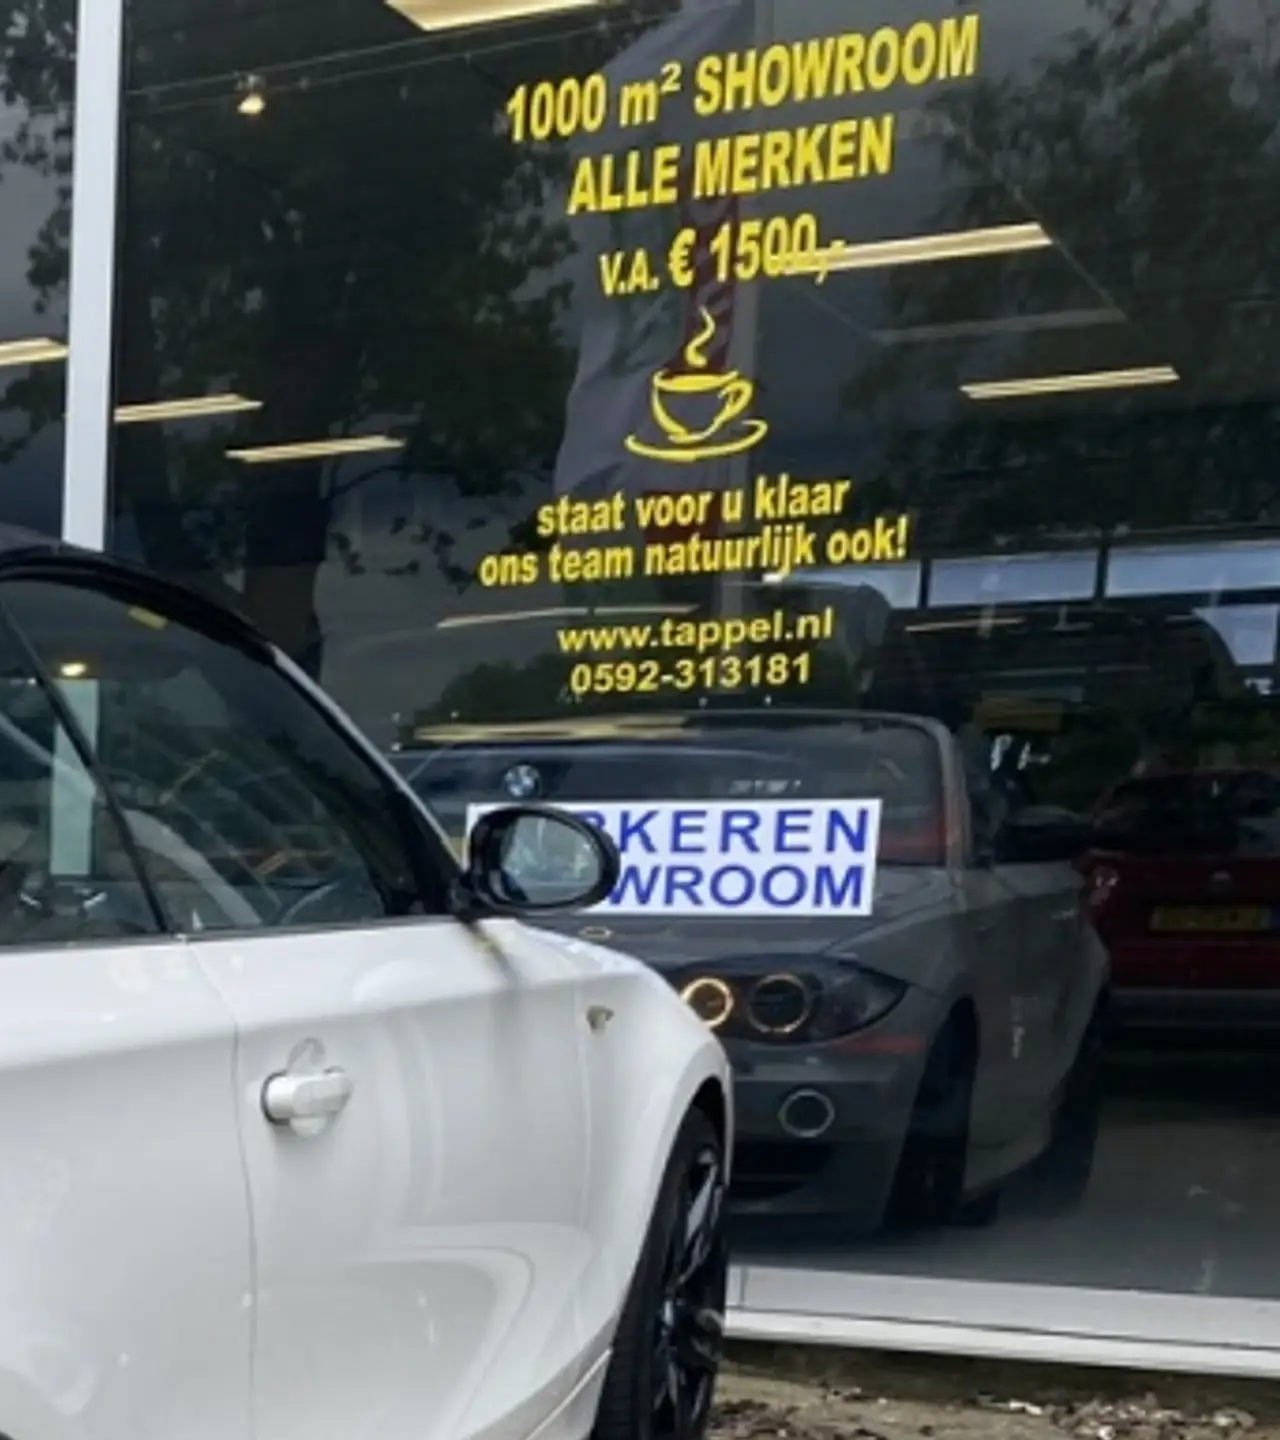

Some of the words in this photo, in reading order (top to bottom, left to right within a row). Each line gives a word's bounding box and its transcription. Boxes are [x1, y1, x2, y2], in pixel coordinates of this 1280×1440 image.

[506, 73, 607, 143] 1000
[693, 15, 979, 116] SHOWROOM
[568, 145, 681, 215] ALLE
[693, 114, 894, 200] MERKEN
[669, 227, 697, 288] €
[537, 491, 626, 537] staat
[637, 488, 713, 528] voor
[720, 486, 744, 513] u
[753, 473, 852, 520] klaar
[479, 551, 540, 587] ons
[549, 541, 635, 583] team
[644, 522, 816, 579] natuurlijk
[826, 515, 911, 564] ook!
[556, 607, 835, 655] www.tappel.nl
[569, 651, 812, 695] 0592-313181
